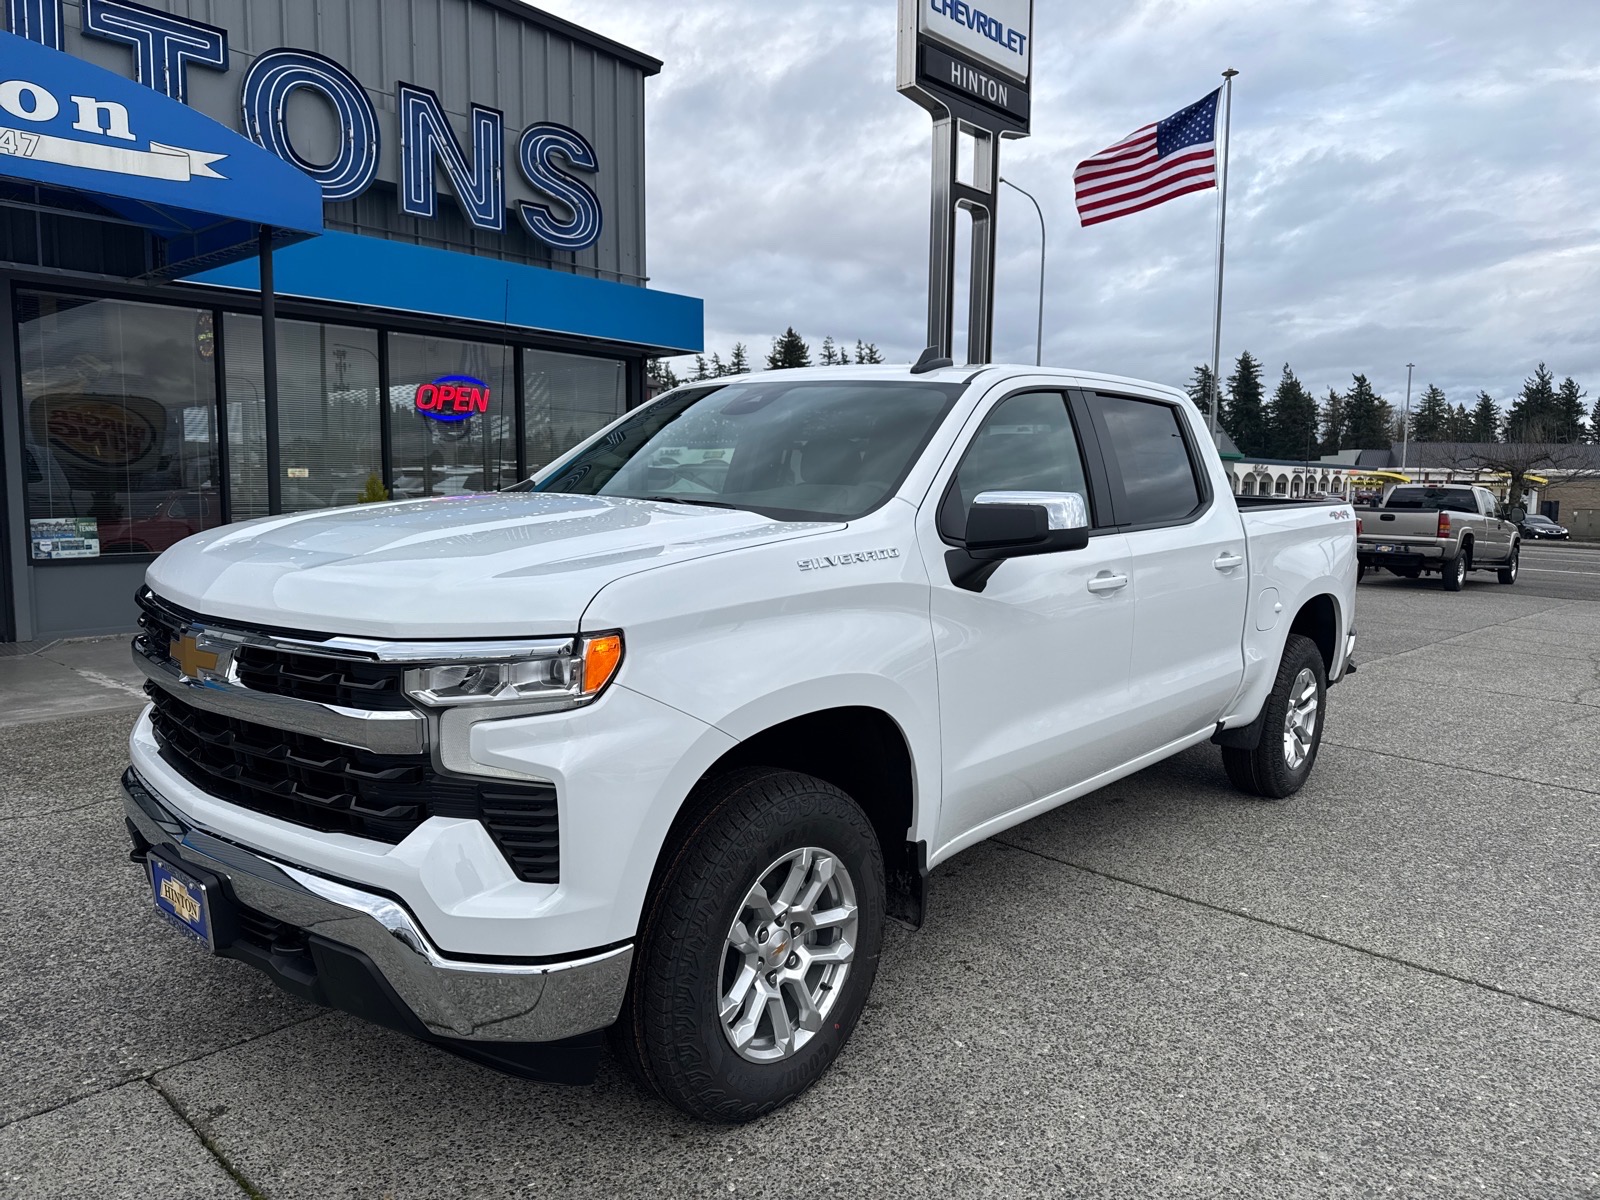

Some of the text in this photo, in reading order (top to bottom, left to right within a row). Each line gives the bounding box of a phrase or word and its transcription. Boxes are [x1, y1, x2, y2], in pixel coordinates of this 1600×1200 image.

[951, 61, 1008, 107] HINTON
[0, 130, 40, 157] 47
[415, 384, 490, 413] OPEN
[797, 548, 900, 572] SILVERADO
[164, 884, 198, 917] HINTON
